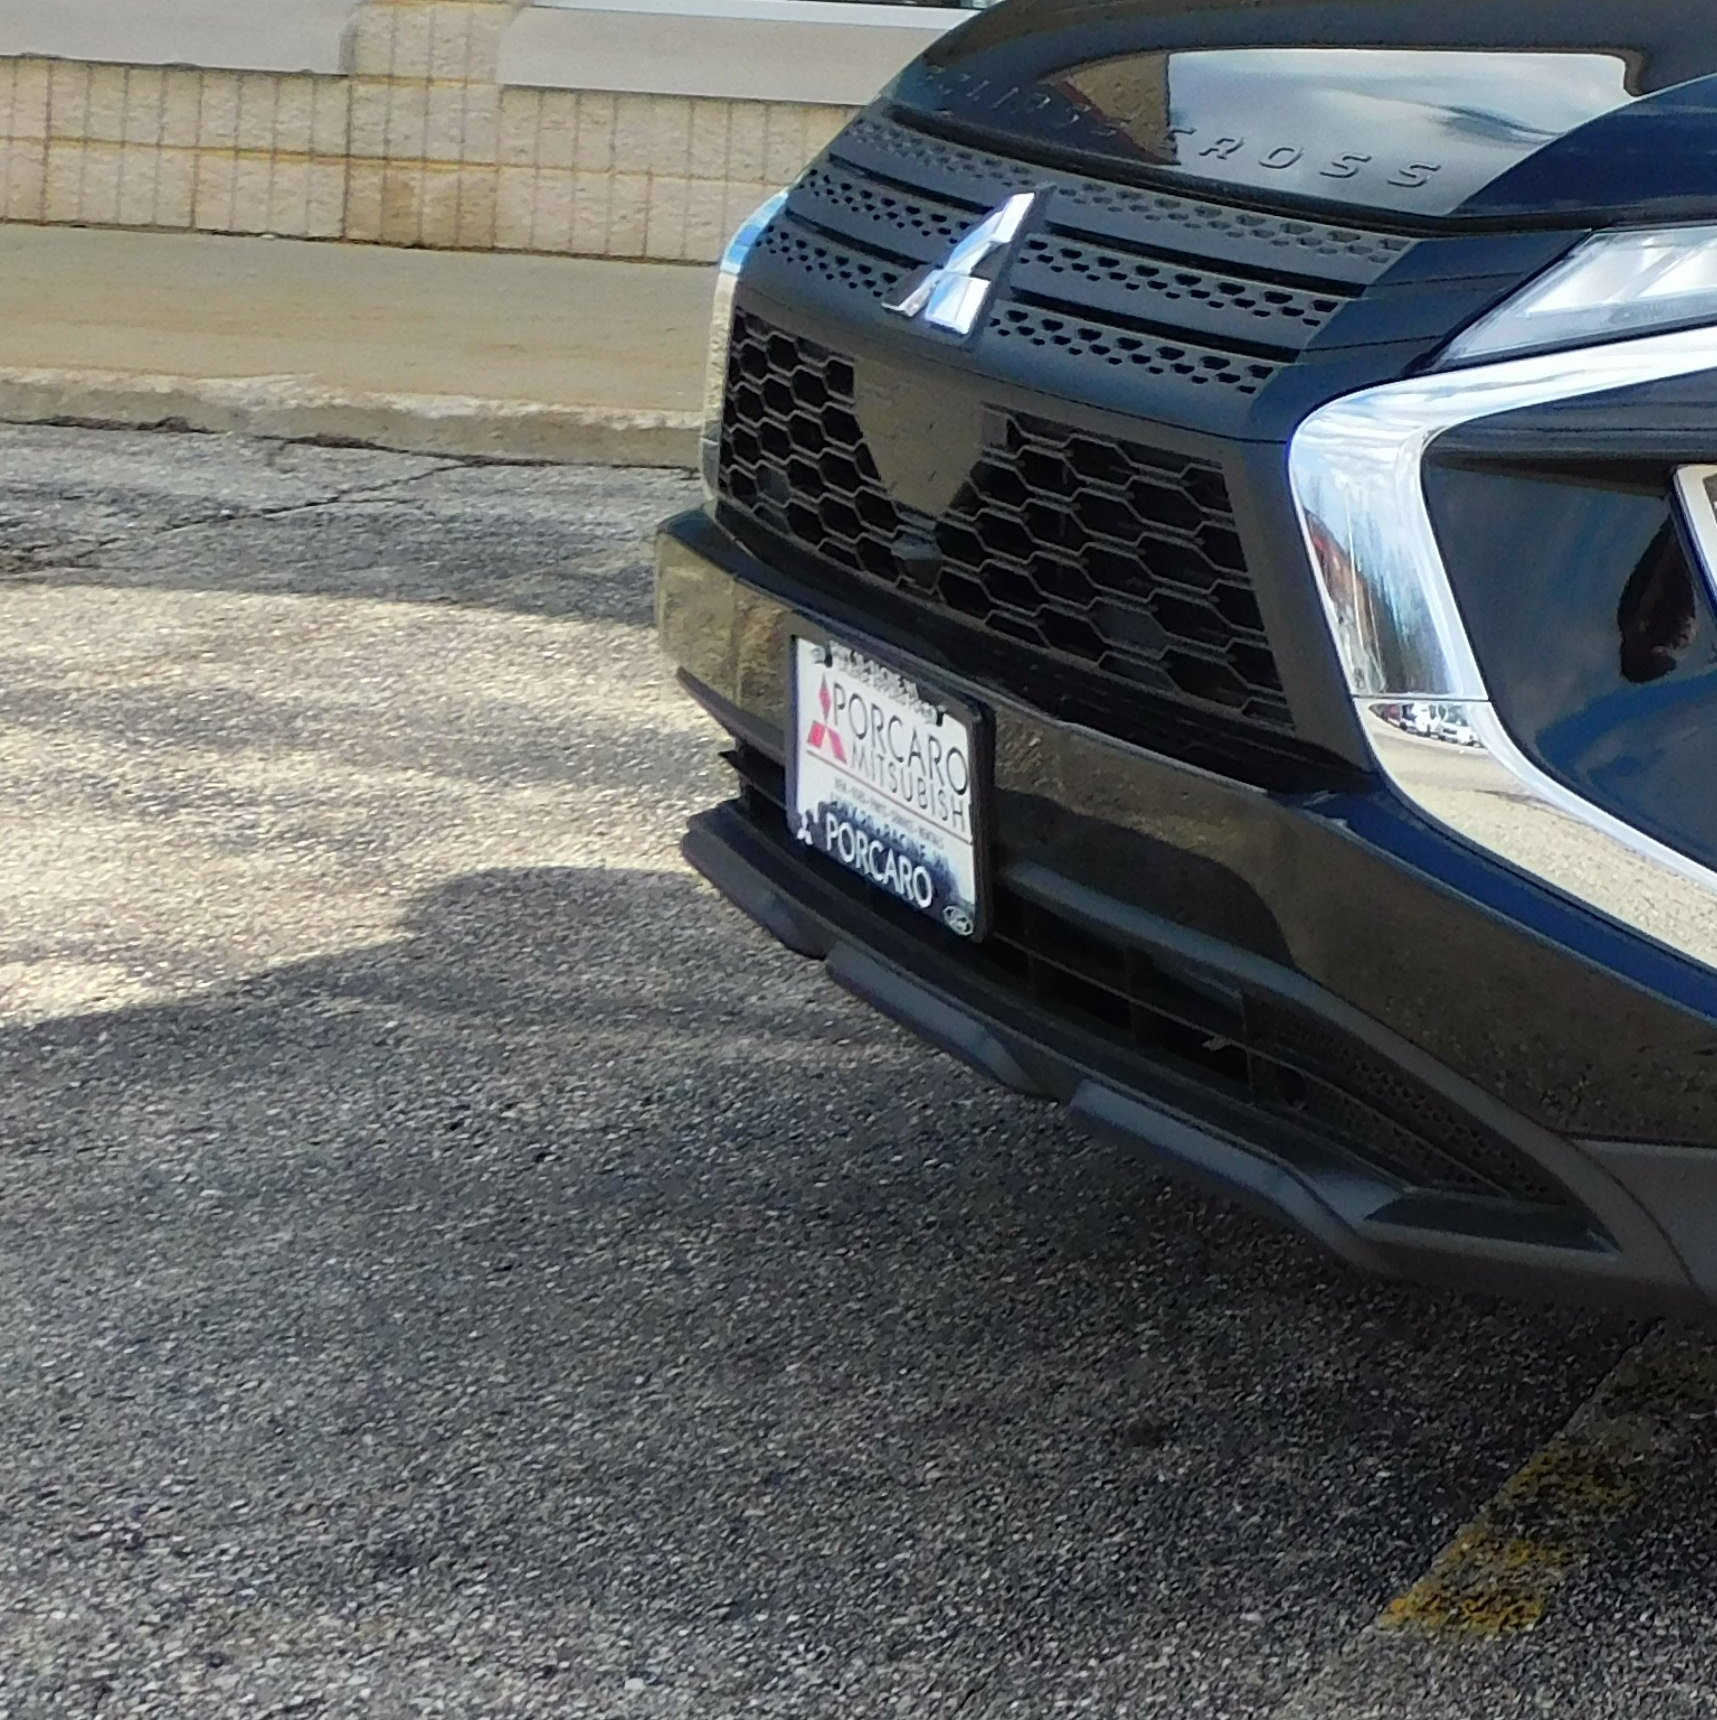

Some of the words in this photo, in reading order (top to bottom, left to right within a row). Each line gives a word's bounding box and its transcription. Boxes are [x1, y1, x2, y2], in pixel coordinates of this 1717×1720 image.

[832, 681, 969, 796] PORCARO
[850, 741, 967, 833] MITSUBISH
[825, 811, 933, 909] PORCARO
